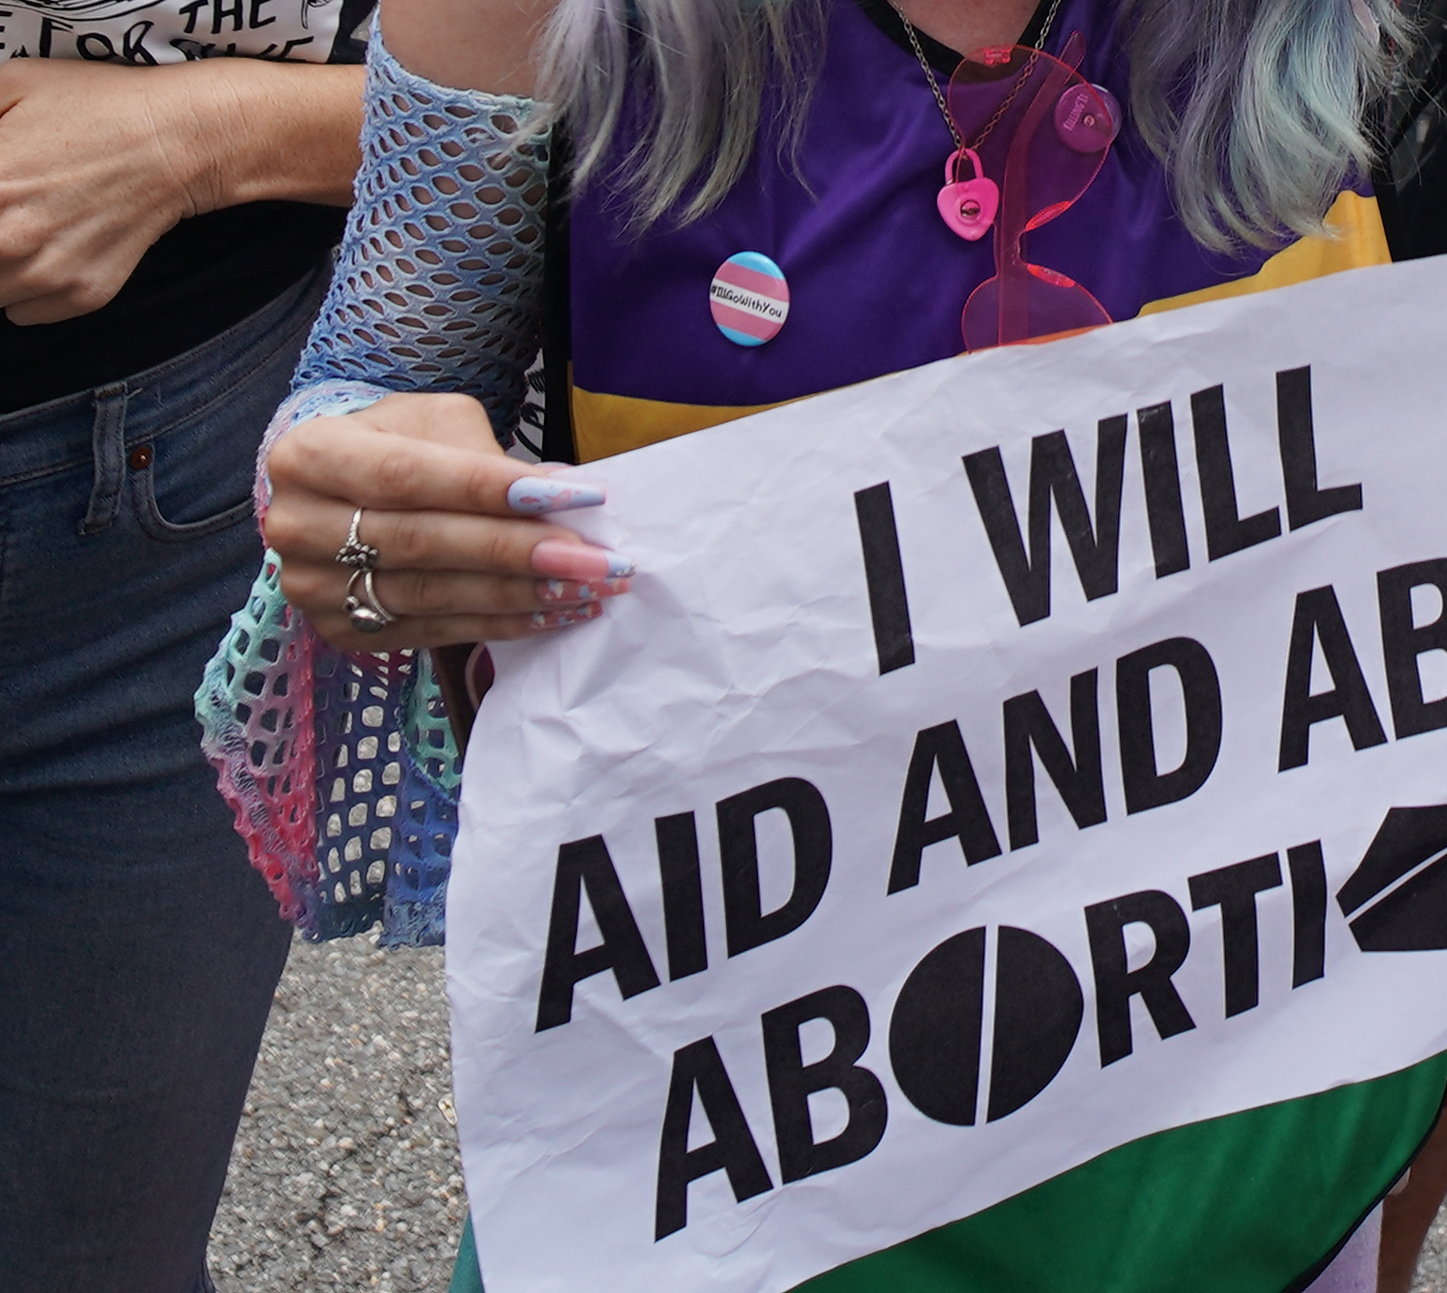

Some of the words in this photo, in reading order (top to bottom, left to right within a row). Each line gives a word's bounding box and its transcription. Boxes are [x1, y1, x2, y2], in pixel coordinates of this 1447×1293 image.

[854, 480, 915, 675] I
[962, 364, 1364, 628] WILL
[534, 775, 833, 1035] AID
[886, 634, 1223, 897] AND
